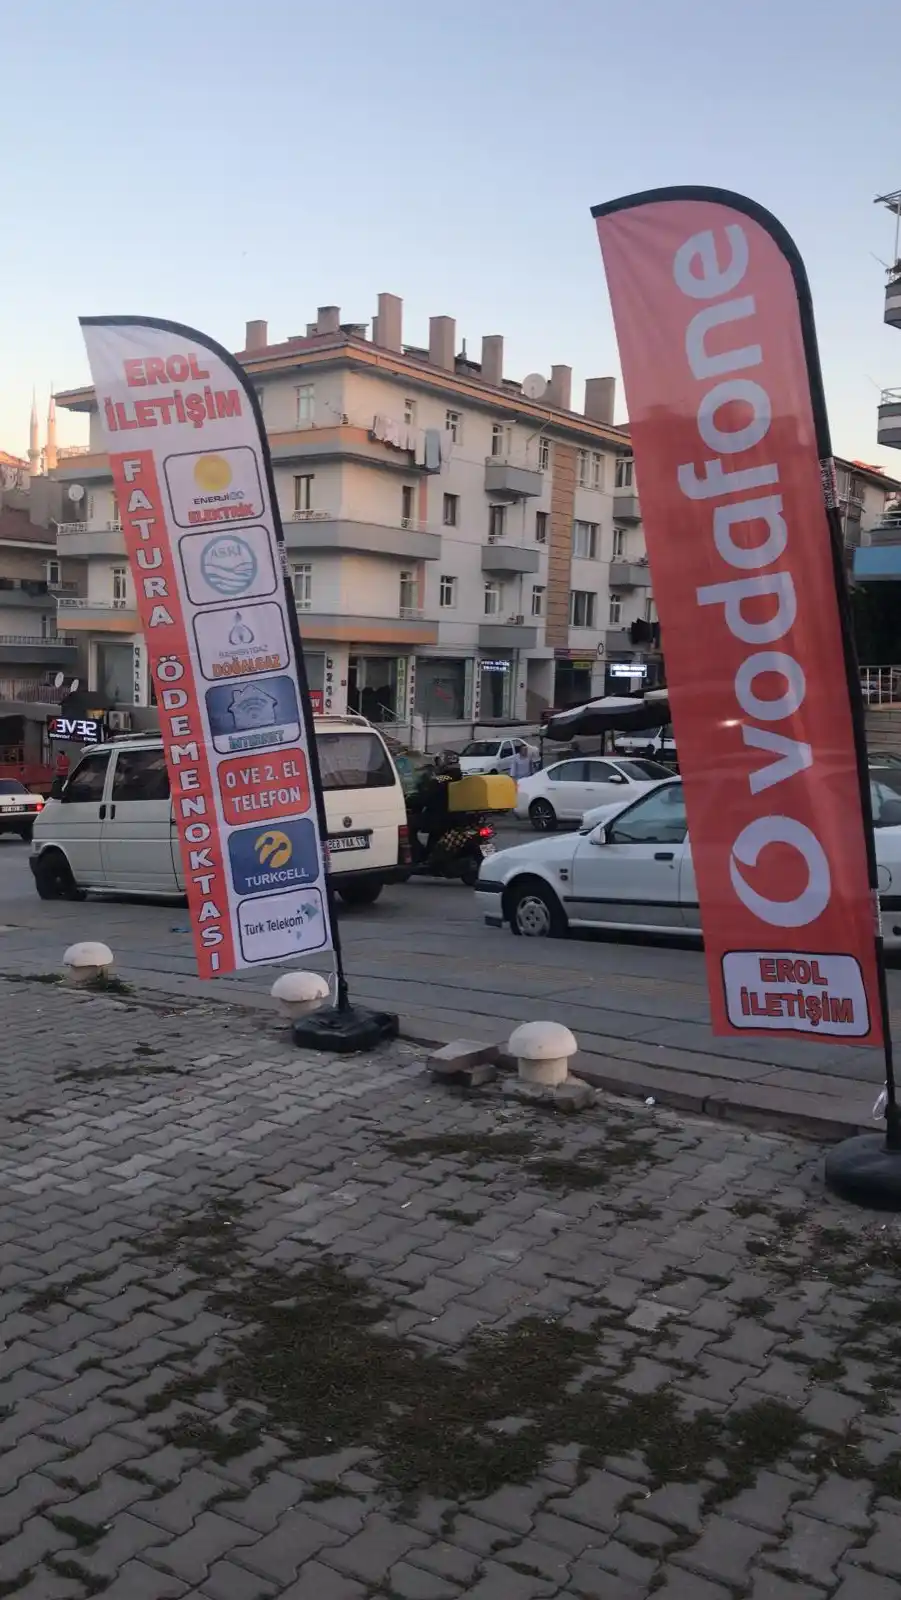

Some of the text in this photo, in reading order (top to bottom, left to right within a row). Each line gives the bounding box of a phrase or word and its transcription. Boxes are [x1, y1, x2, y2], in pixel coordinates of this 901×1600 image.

[123, 353, 210, 387] EROL
[104, 385, 242, 431] İLETİŞİM
[673, 223, 813, 795] vodafone
[122, 458, 175, 628] FATURA
[240, 767, 261, 784] VE
[264, 765, 279, 781] 2.
[282, 760, 300, 778] EL
[232, 786, 301, 813] TELEFON
[245, 868, 310, 888] TURKCELL
[266, 915, 304, 933] Telekom
[759, 957, 828, 986] EROL
[740, 986, 854, 1026] İLETİŞİM
